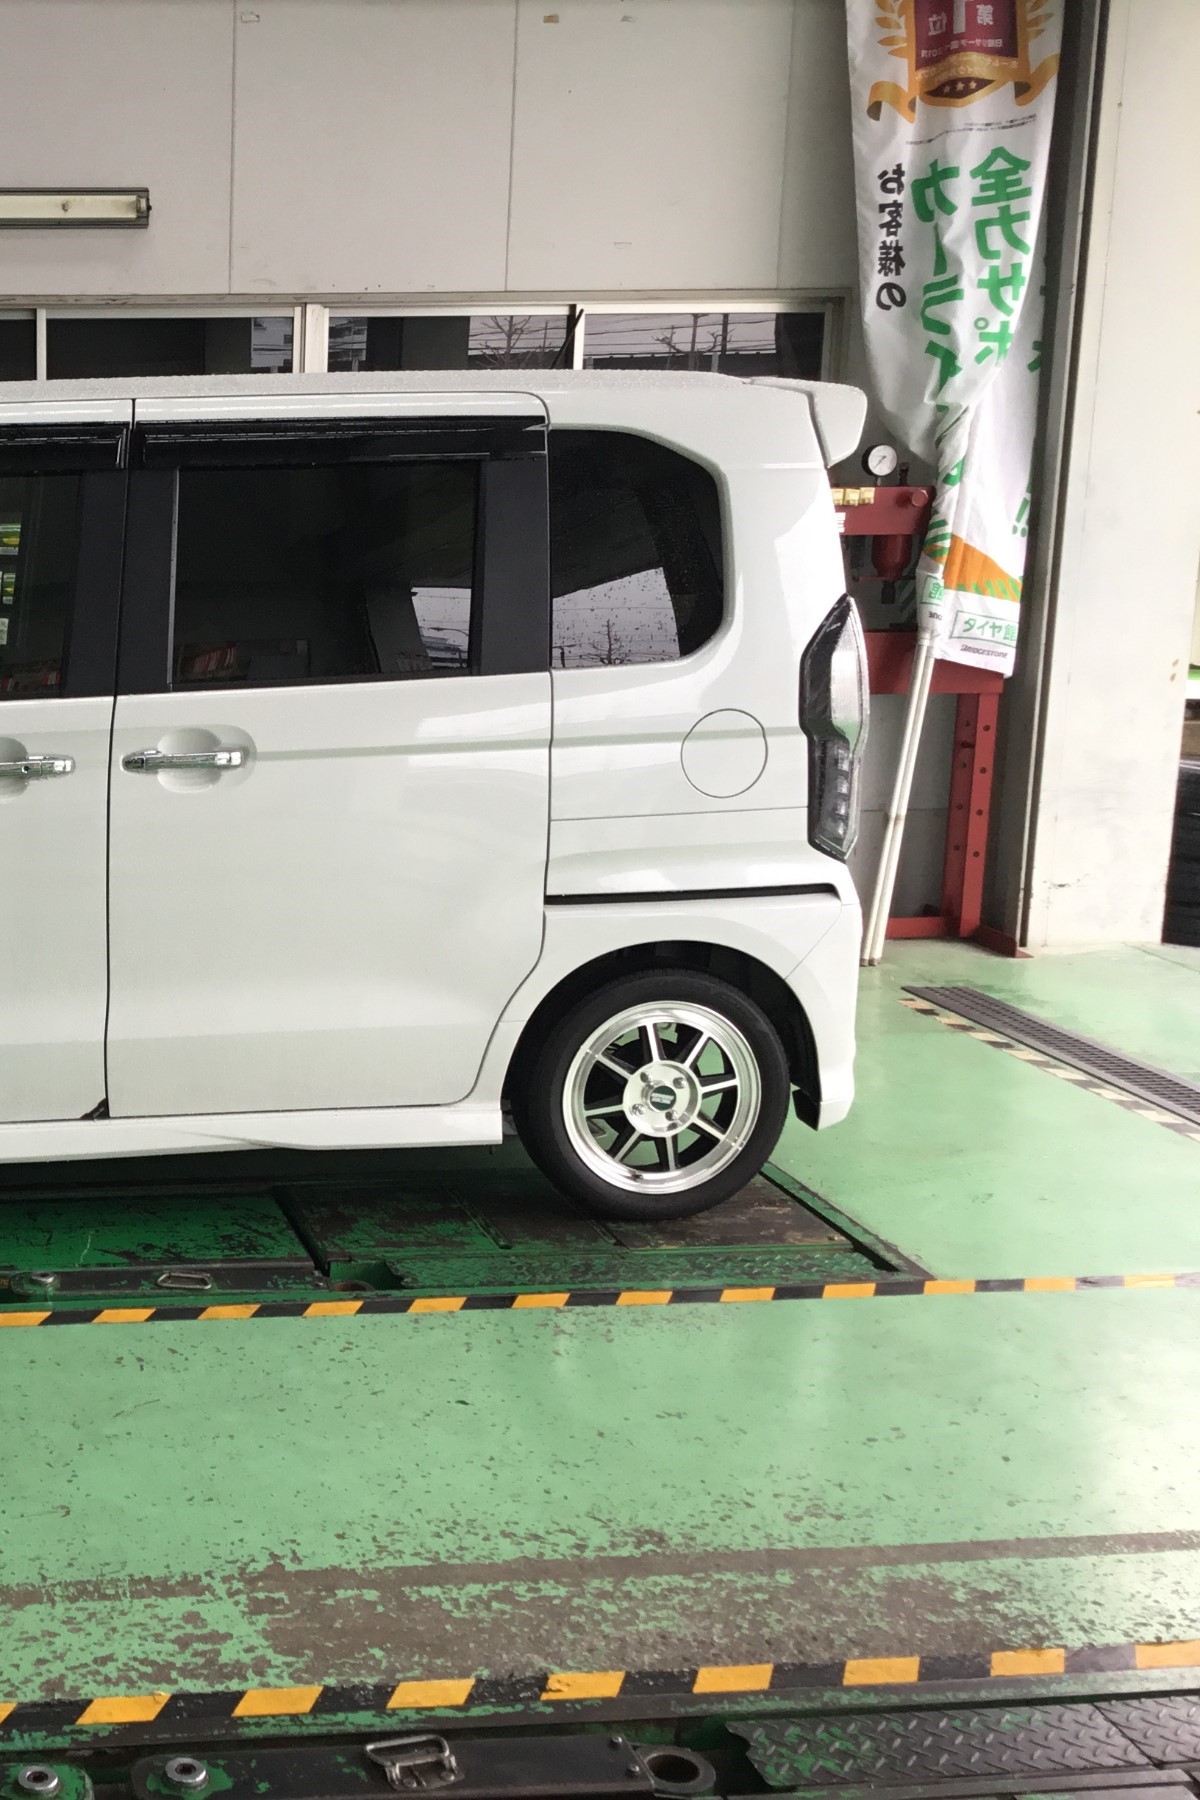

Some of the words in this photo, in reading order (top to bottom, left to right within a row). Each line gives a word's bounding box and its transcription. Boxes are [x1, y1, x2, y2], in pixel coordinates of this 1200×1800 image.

[962, 617, 1017, 643] タイヤ館
[960, 643, 1009, 659] BRIDGESTONE
